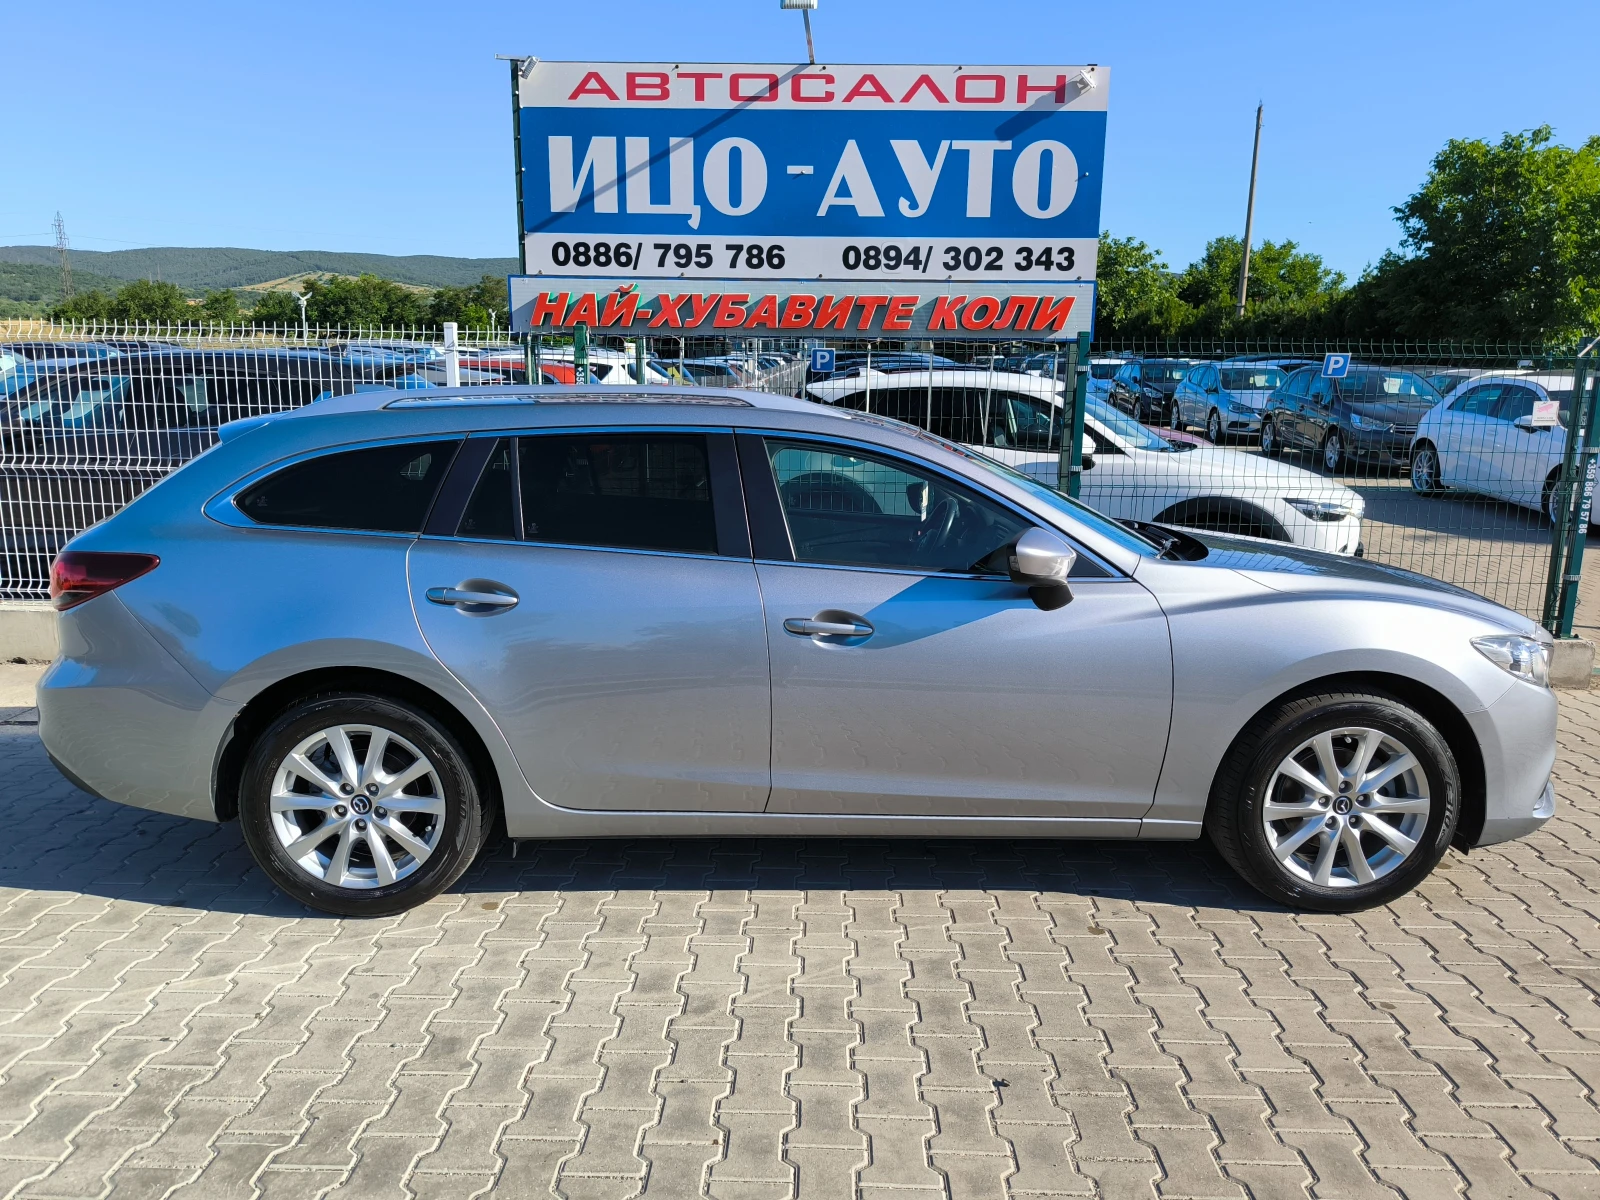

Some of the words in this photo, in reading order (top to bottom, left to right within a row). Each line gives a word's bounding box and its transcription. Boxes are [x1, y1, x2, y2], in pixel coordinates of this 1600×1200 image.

[568, 71, 1067, 104] АВТОСАЛОН
[548, 135, 768, 229] ИЦО
[551, 241, 642, 270] 0886/
[653, 242, 713, 269] 795
[726, 243, 786, 270] 786
[842, 245, 932, 273] 0894/
[943, 246, 1003, 272] 302
[1014, 247, 1075, 272] 343
[530, 284, 921, 331] НАЙ-ХУБАВИТЕ
[927, 295, 1076, 331] КОЛИ
[816, 351, 830, 368] P
[1327, 356, 1344, 374] P
[1587, 459, 1596, 479] +359
[1584, 481, 1594, 497] 886
[1582, 499, 1591, 509] 79
[1581, 511, 1589, 522] 57
[1578, 523, 1588, 534] 86
